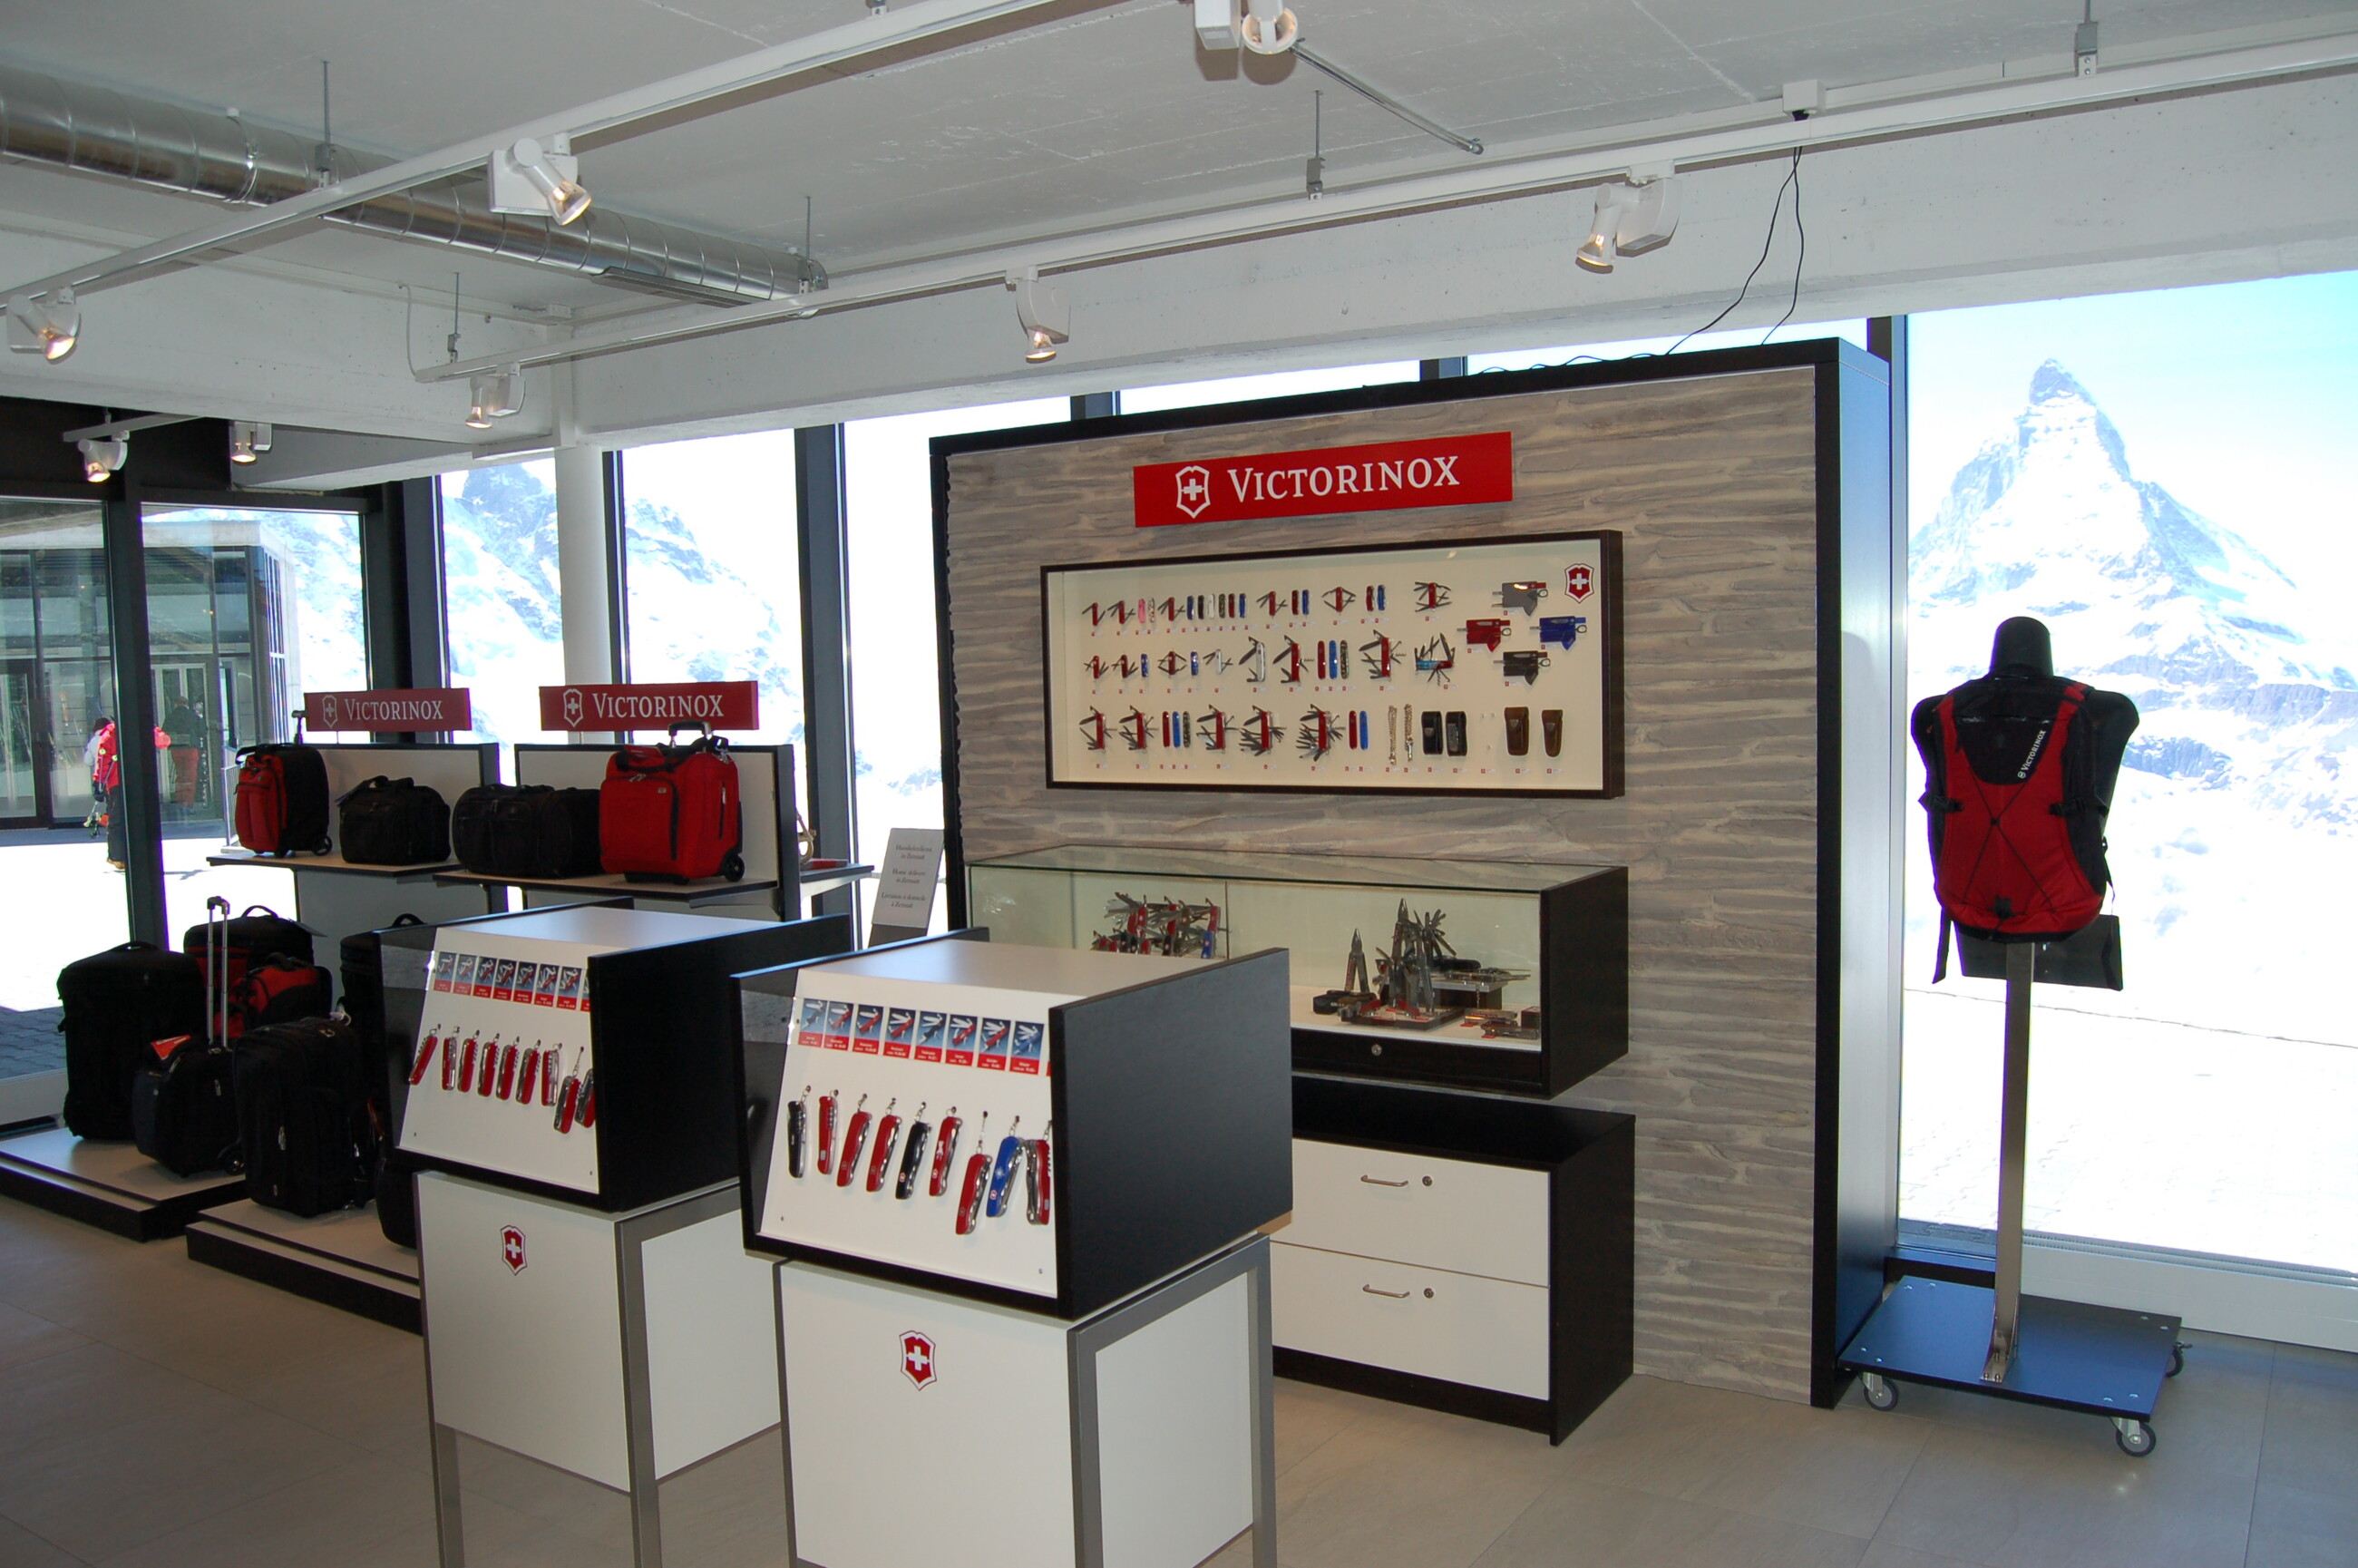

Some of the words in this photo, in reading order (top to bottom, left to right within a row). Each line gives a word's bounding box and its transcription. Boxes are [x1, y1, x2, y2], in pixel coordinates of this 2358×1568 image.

[1227, 455, 1460, 502] VICTORINOX
[344, 698, 443, 722] VICTORINOX
[593, 694, 724, 720] VICTORINOX
[2021, 730, 2046, 770] VICTORINOX
